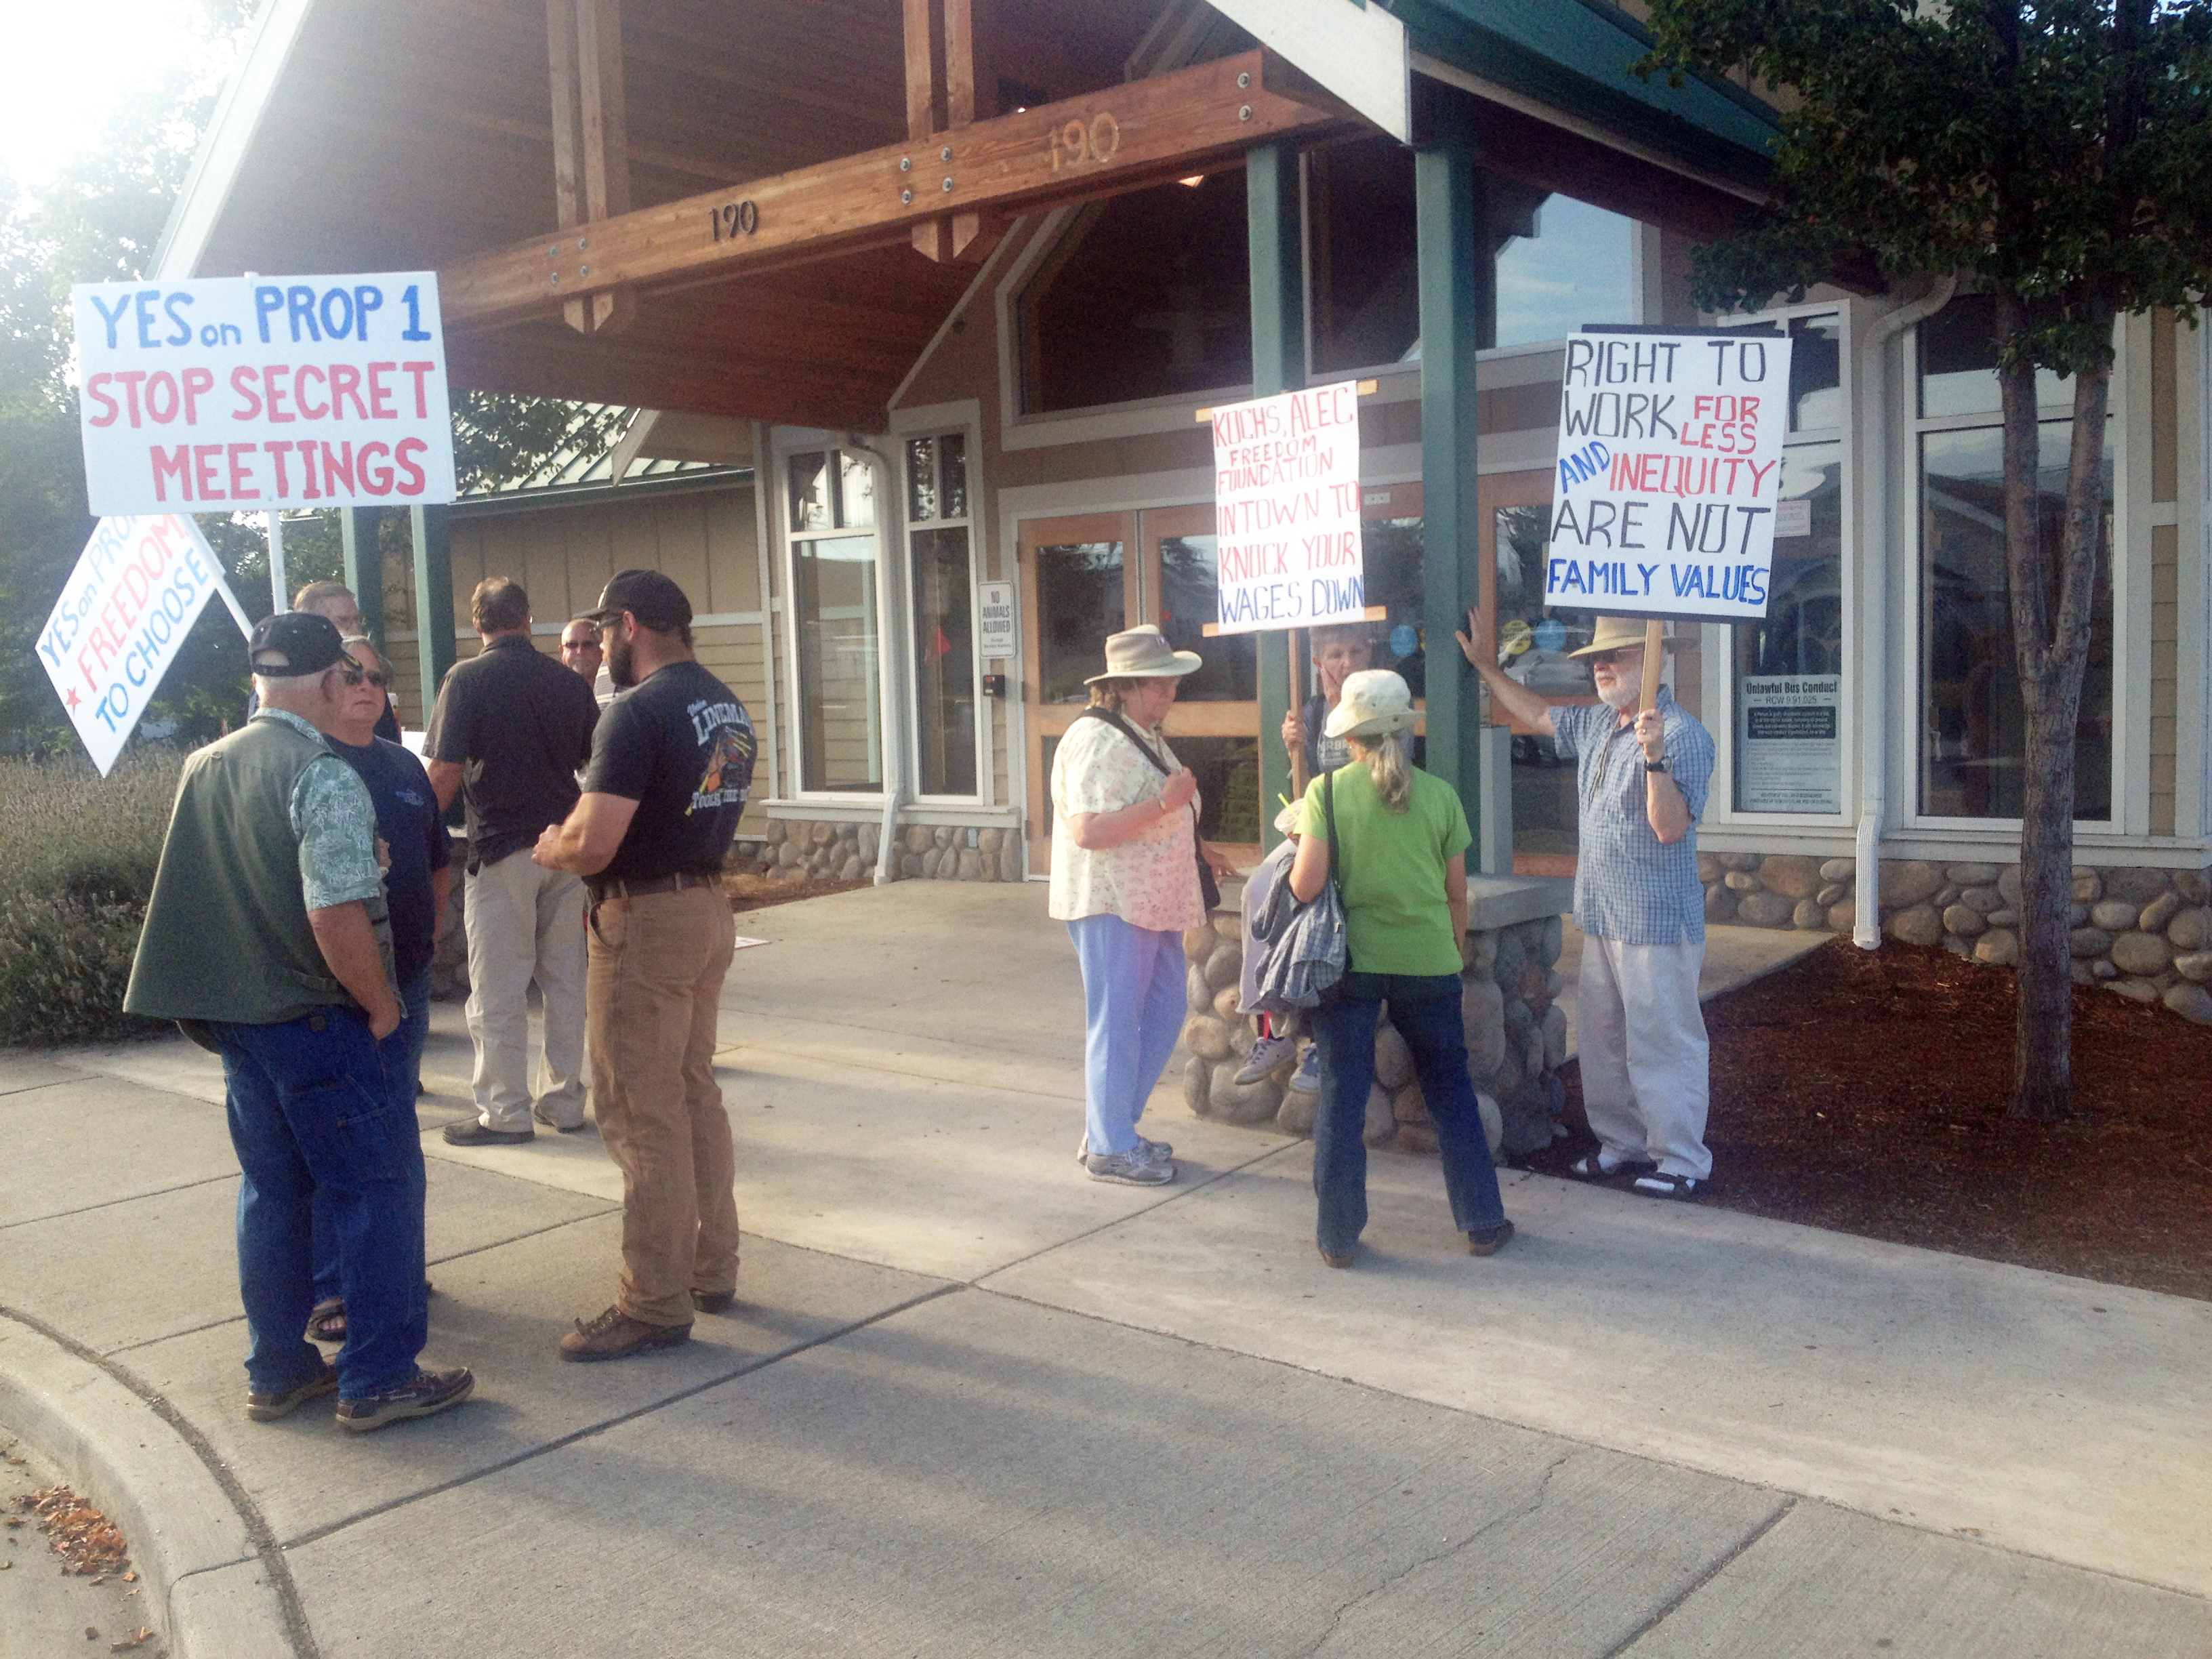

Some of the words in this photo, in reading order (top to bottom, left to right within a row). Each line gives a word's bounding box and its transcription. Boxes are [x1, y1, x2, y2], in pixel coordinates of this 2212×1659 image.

[1048, 112, 1120, 172] 190
[710, 199, 758, 241] 190
[91, 289, 195, 349] YES
[201, 324, 241, 348] on
[255, 285, 384, 345] PROP
[401, 285, 432, 342] 1
[1565, 340, 1681, 387] RIGHT
[1707, 340, 1766, 385] TO
[87, 366, 214, 428] STOP
[230, 361, 435, 423] SECRET
[1565, 390, 1678, 439] WORK
[1694, 395, 1761, 423] FOR
[1230, 434, 1317, 467] FREEDOM
[1681, 422, 1757, 455] LESS
[150, 437, 428, 501] MEETINGS
[1218, 447, 1333, 495] FOUNDATION
[1559, 441, 1610, 493] AND
[1610, 453, 1776, 498] INEQUITY
[1330, 480, 1360, 518] TO
[1551, 499, 1649, 548] ARE
[1667, 502, 1771, 554] NOT
[1220, 541, 1288, 585] KNOCK
[1302, 531, 1355, 570] YOUR
[1548, 558, 1660, 596] FAMILY
[1671, 564, 1769, 605] VALUES
[77, 513, 185, 693] FREEDOM
[983, 605, 1010, 619] ANIMALS
[991, 591, 1001, 603] NO
[1220, 581, 1302, 624] WAGES
[1312, 574, 1364, 617] DOWN
[41, 600, 79, 668] YES
[79, 583, 98, 617] on
[95, 682, 129, 733] TO
[125, 547, 209, 687] CHOOSE
[983, 621, 1010, 634] ALLOWED
[1746, 682, 1782, 695] Unlawful
[1784, 682, 1800, 693] Bus
[1802, 681, 1837, 693] Conduct
[1765, 696, 1785, 704] RCW
